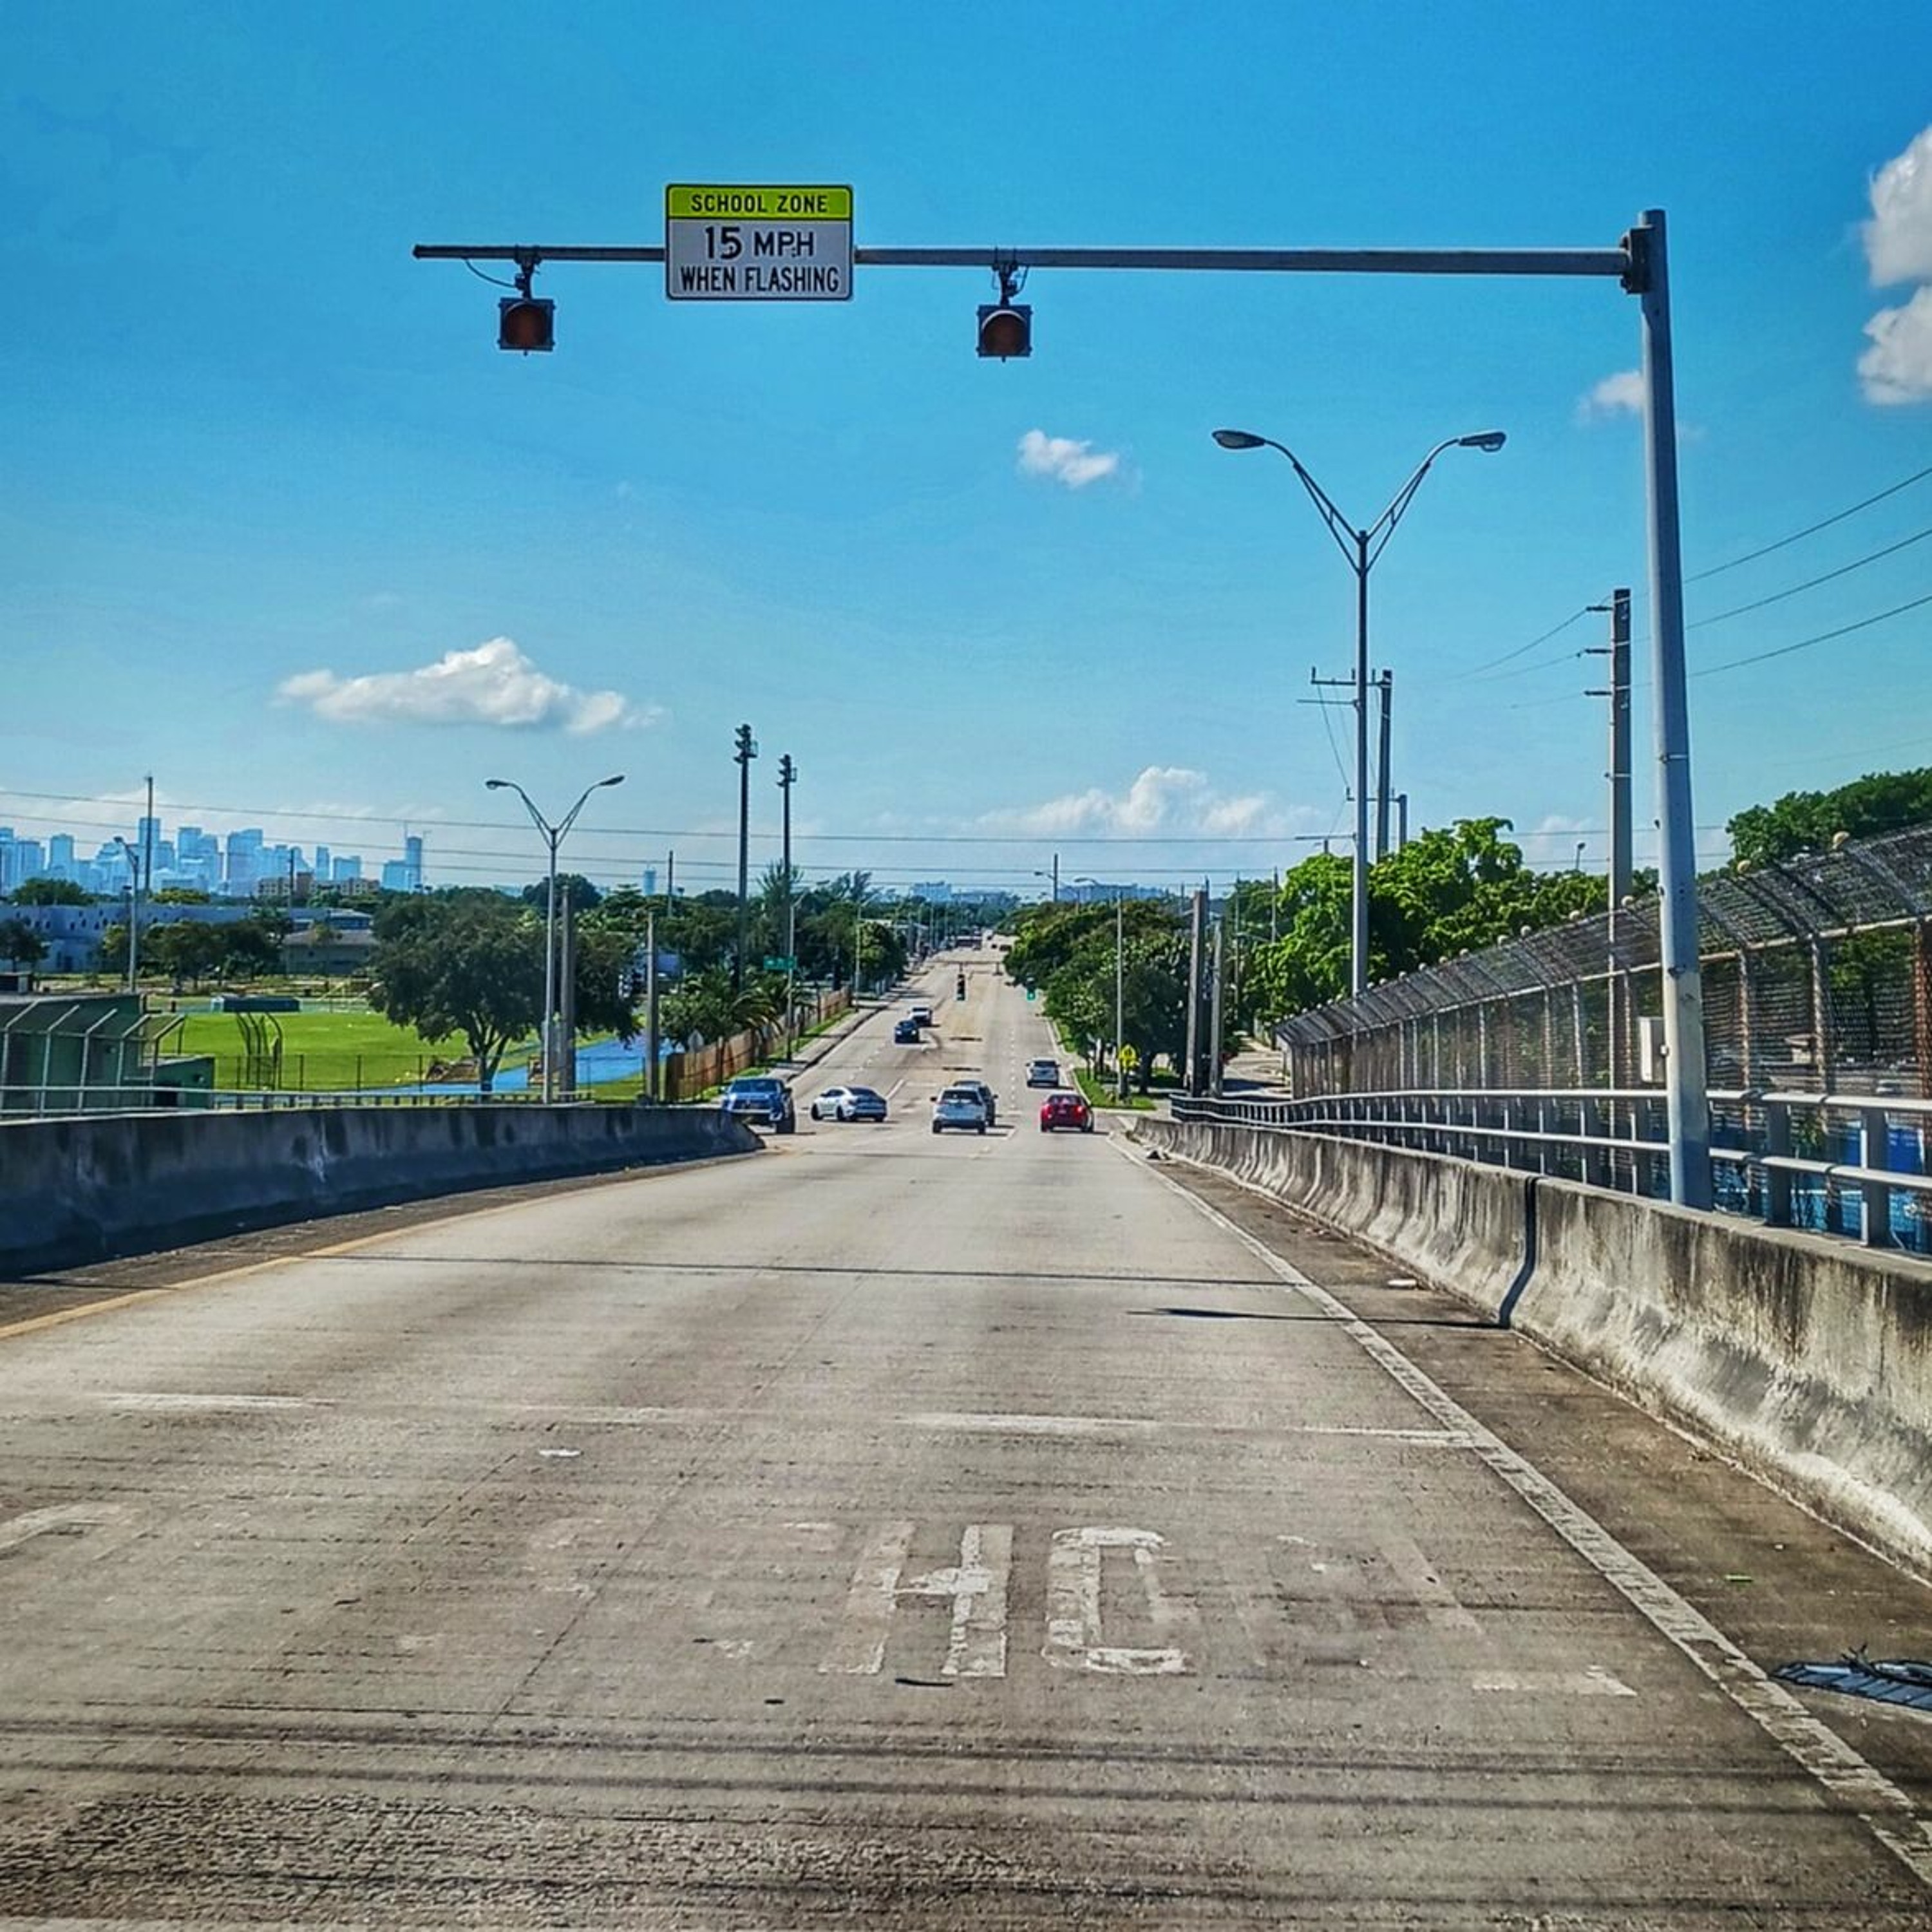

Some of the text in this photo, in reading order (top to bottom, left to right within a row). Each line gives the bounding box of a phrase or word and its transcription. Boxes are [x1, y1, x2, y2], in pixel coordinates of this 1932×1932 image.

[691, 194, 828, 213] SCHOOL ZONE
[705, 226, 815, 260] 15 MPH
[680, 266, 839, 292] WHEN FLASHING
